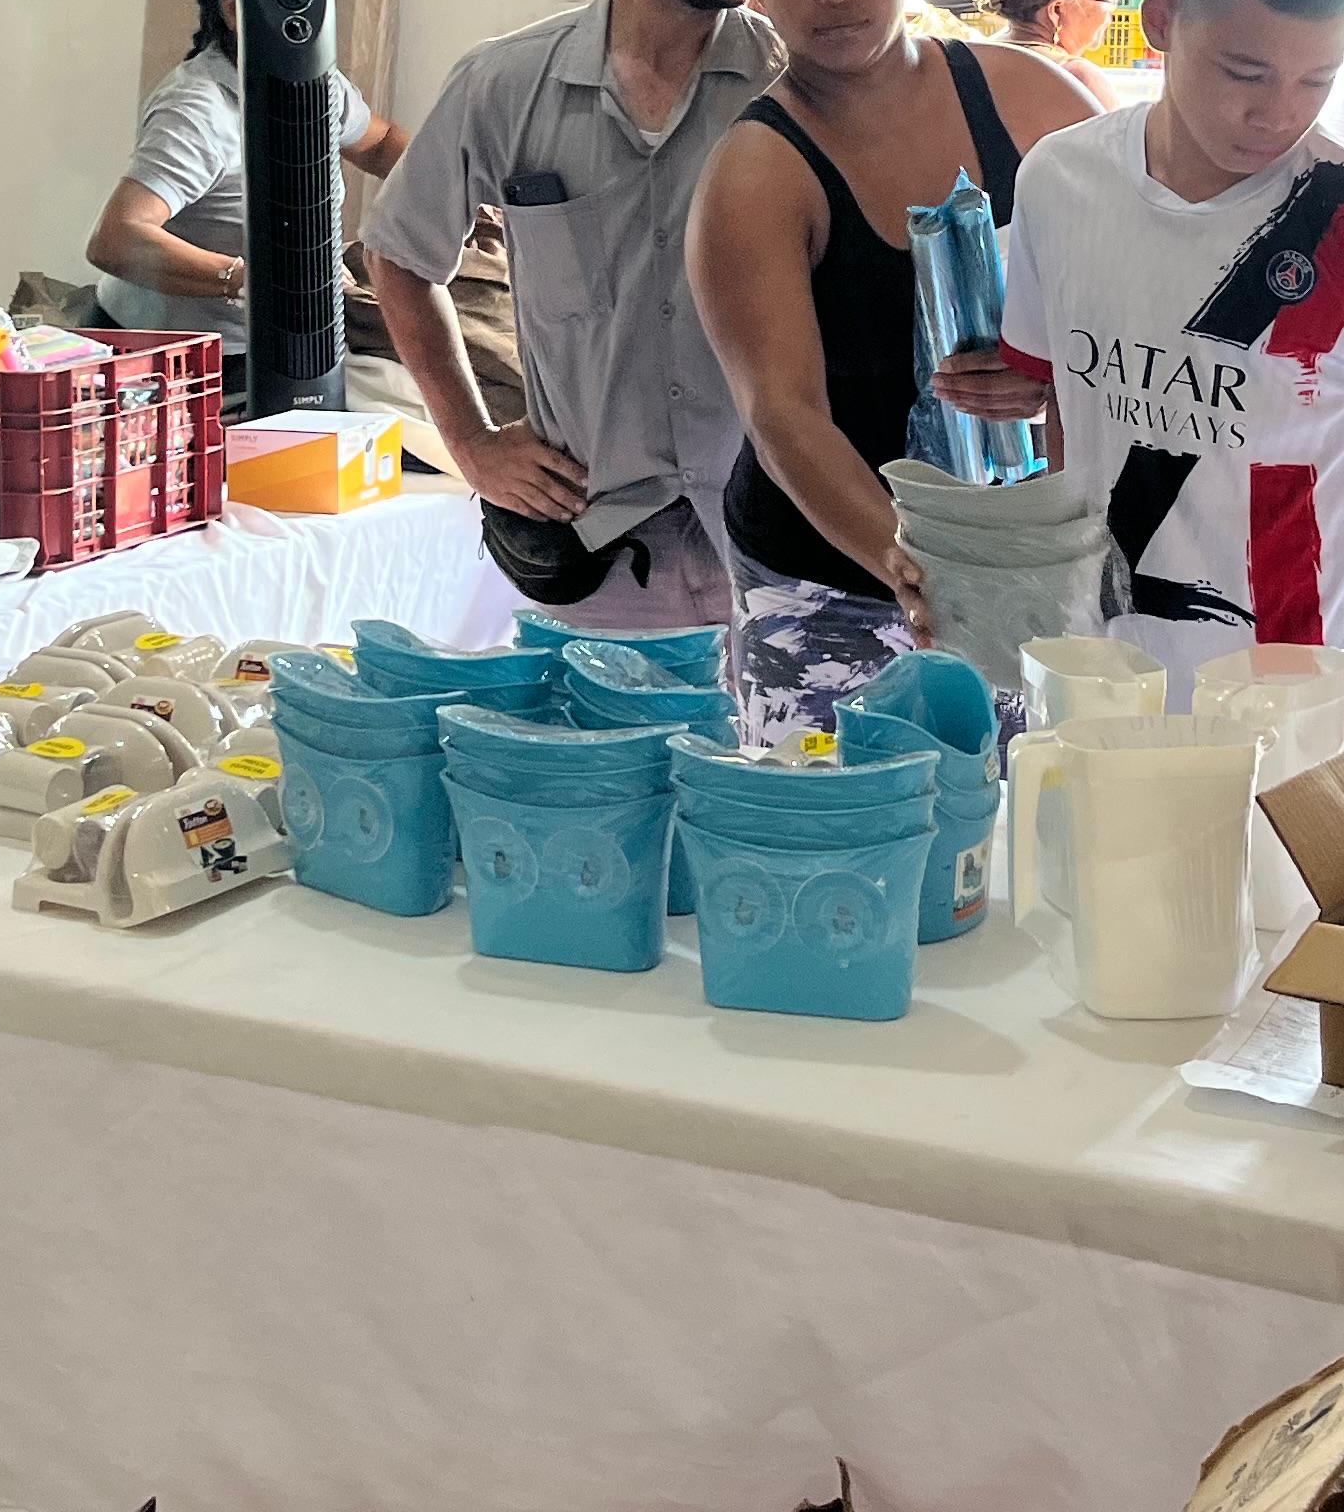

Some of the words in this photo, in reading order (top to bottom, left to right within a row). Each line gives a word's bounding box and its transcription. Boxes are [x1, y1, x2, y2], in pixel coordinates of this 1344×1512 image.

[1066, 329, 1247, 412] QATAR
[293, 394, 324, 405] SIMPLY
[1104, 392, 1248, 449] AIRWAYS
